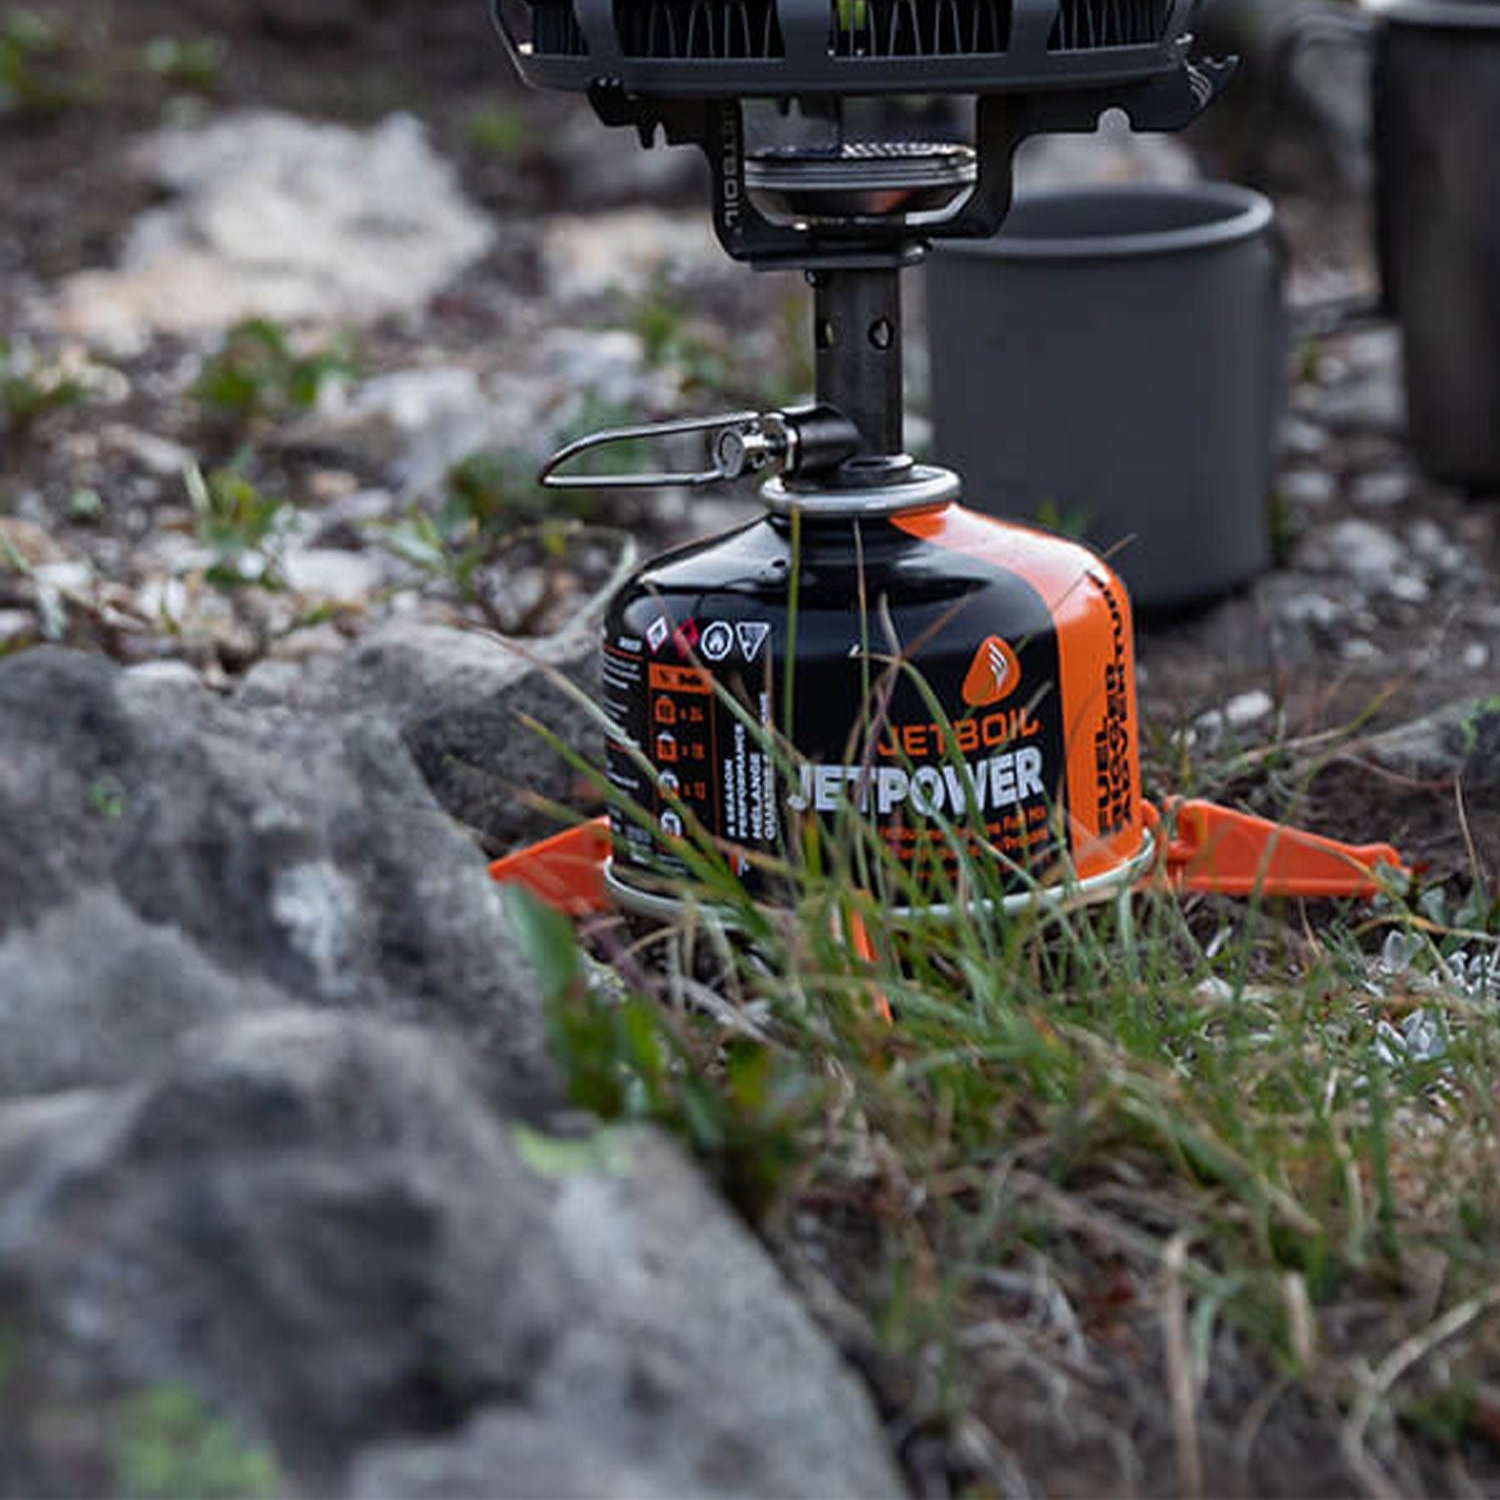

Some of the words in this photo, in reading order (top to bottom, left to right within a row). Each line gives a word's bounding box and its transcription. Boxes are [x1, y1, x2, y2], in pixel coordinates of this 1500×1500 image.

[876, 707, 1042, 756] JETBOIL
[724, 759, 736, 823] SEASON
[734, 723, 748, 838] PERFORMANCE
[787, 746, 1044, 816] JETPOWER
[1096, 717, 1112, 837] FUEL
